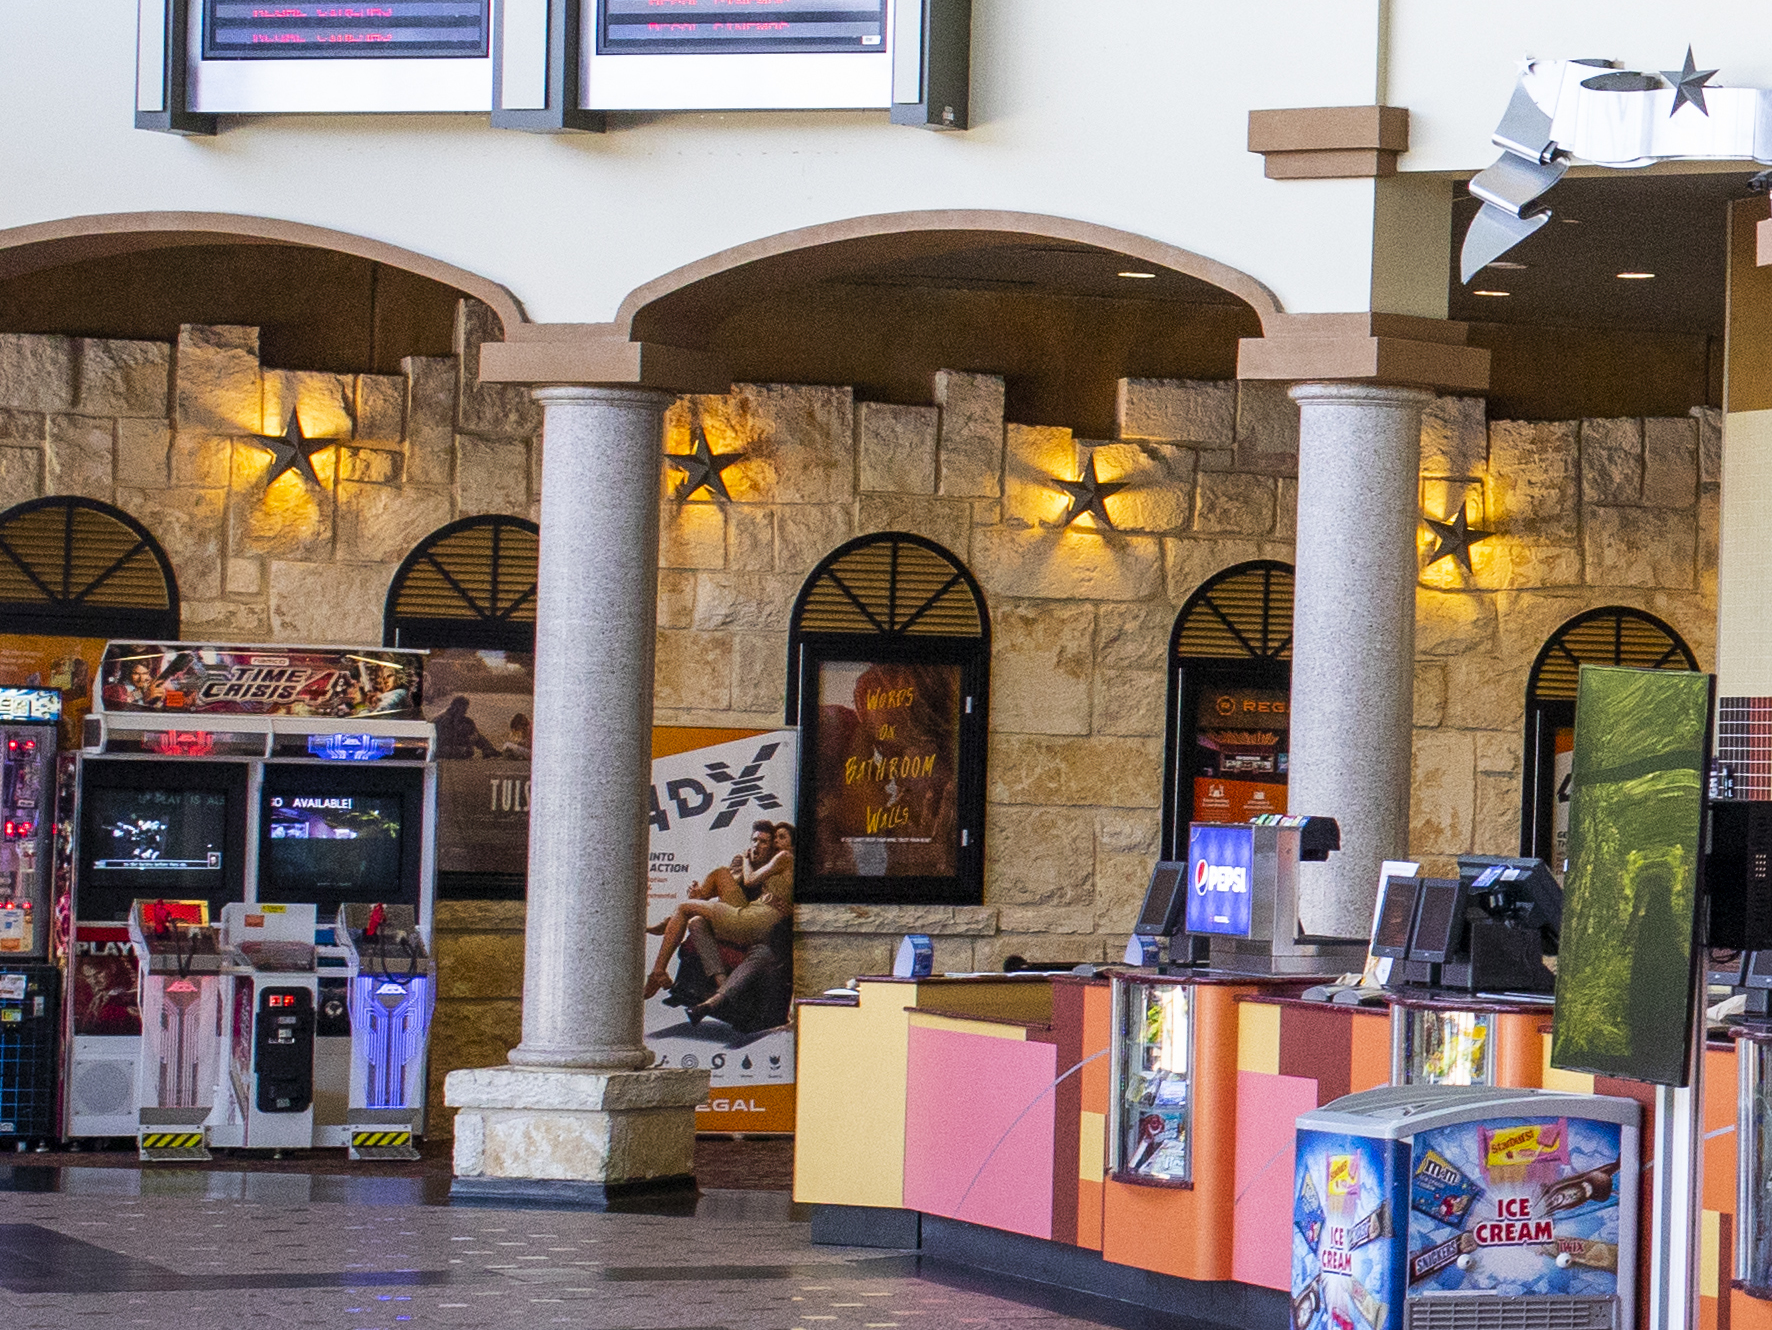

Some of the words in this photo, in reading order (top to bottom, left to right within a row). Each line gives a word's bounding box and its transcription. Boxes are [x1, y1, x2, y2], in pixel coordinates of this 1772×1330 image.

[200, 682, 297, 702] CRISIS
[299, 670, 341, 702] 4
[233, 668, 307, 683] TIME
[845, 754, 936, 784] BATHROOM
[650, 852, 674, 862] INTO
[649, 864, 689, 873] ACTION
[1209, 865, 1246, 893] PEPSI
[1498, 1198, 1530, 1218] ICE
[1330, 1226, 1344, 1247] ICE
[1476, 1222, 1552, 1243] CREAM
[1322, 1249, 1352, 1271] CREAM
[1417, 1241, 1457, 1272] SNICKERS
